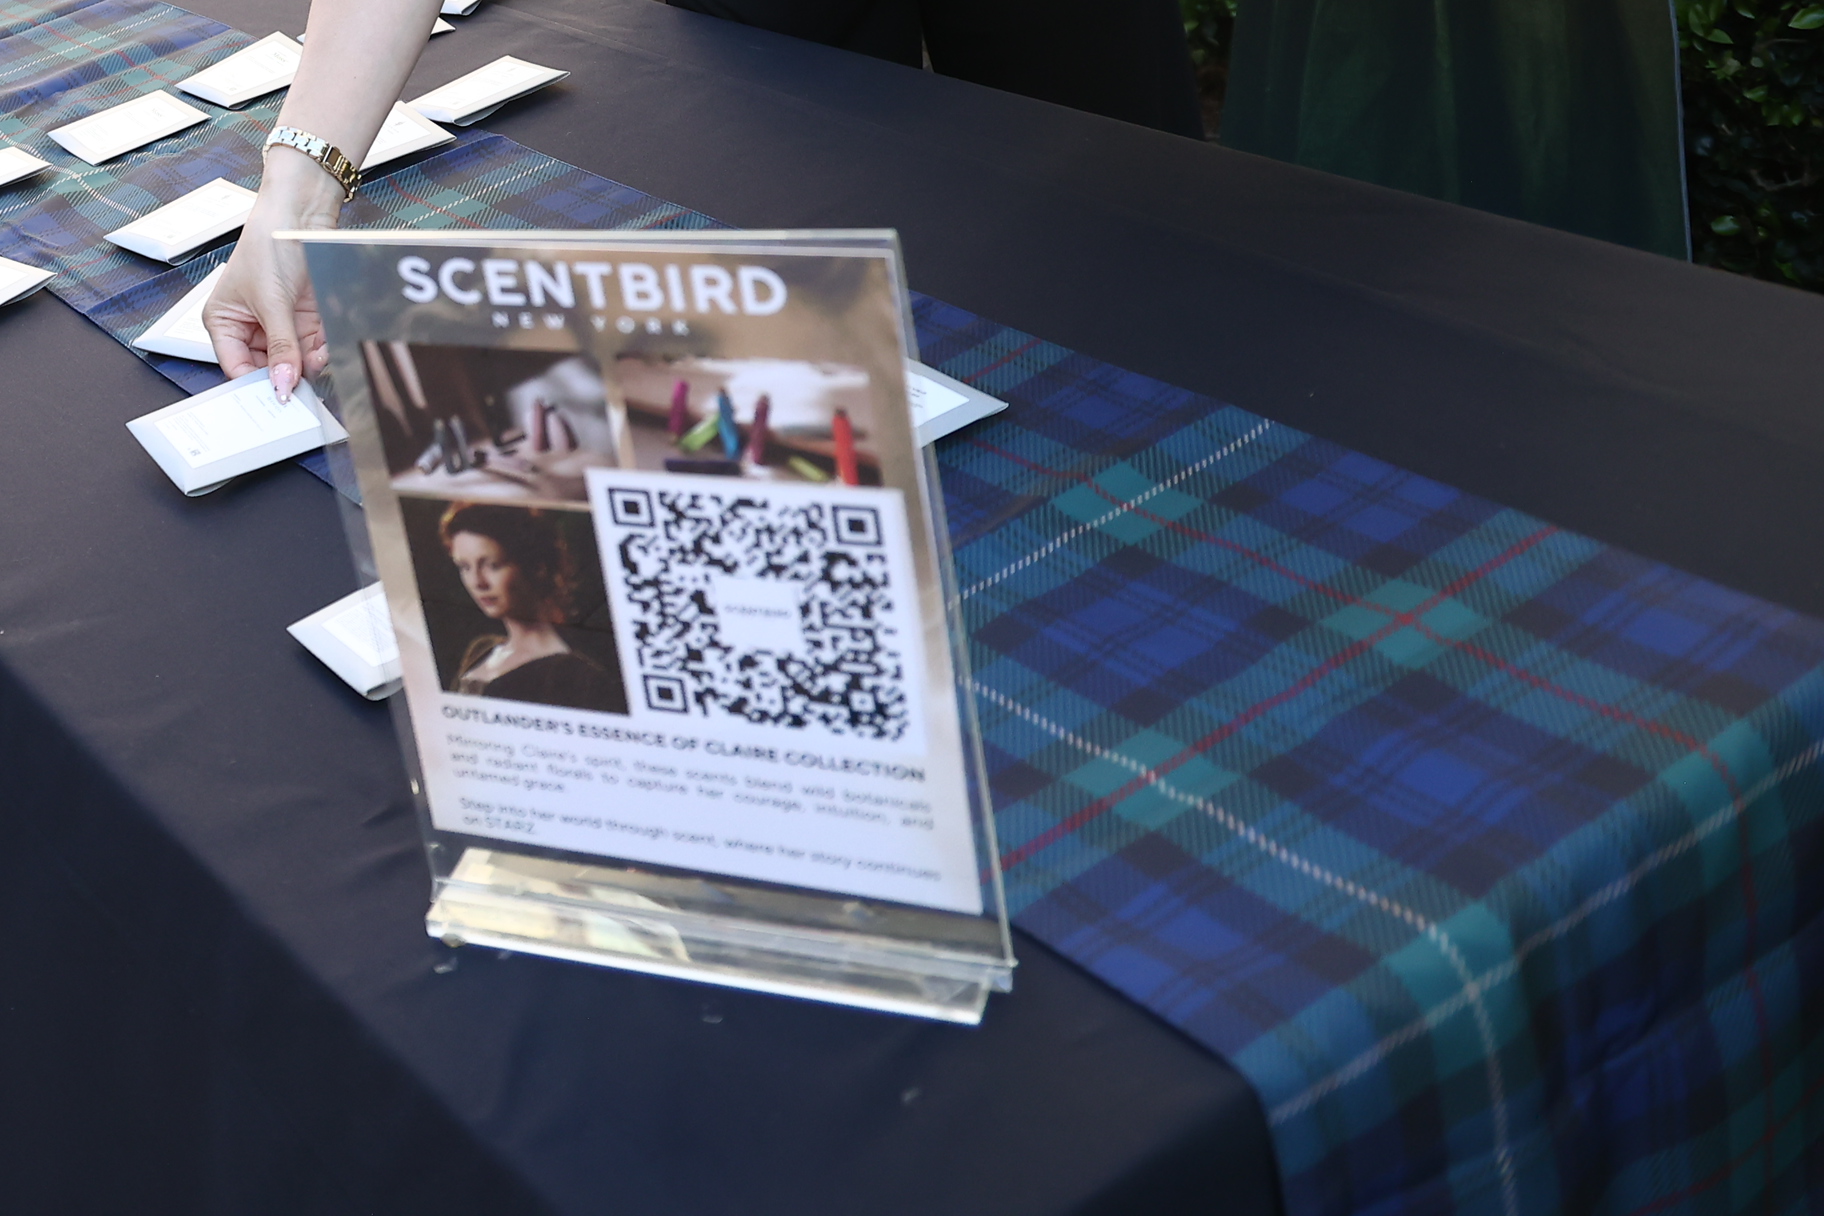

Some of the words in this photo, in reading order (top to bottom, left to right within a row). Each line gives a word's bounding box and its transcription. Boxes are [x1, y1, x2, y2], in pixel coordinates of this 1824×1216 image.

[396, 255, 789, 317] SCENTBIRD
[491, 311, 566, 331] NEW
[591, 314, 691, 337] YORK
[442, 705, 574, 735] OUTLANDER'S
[577, 723, 667, 749] ESSENCE
[672, 735, 698, 751] OF
[705, 740, 777, 764] CLAIRE
[784, 750, 926, 784] COLLECTION
